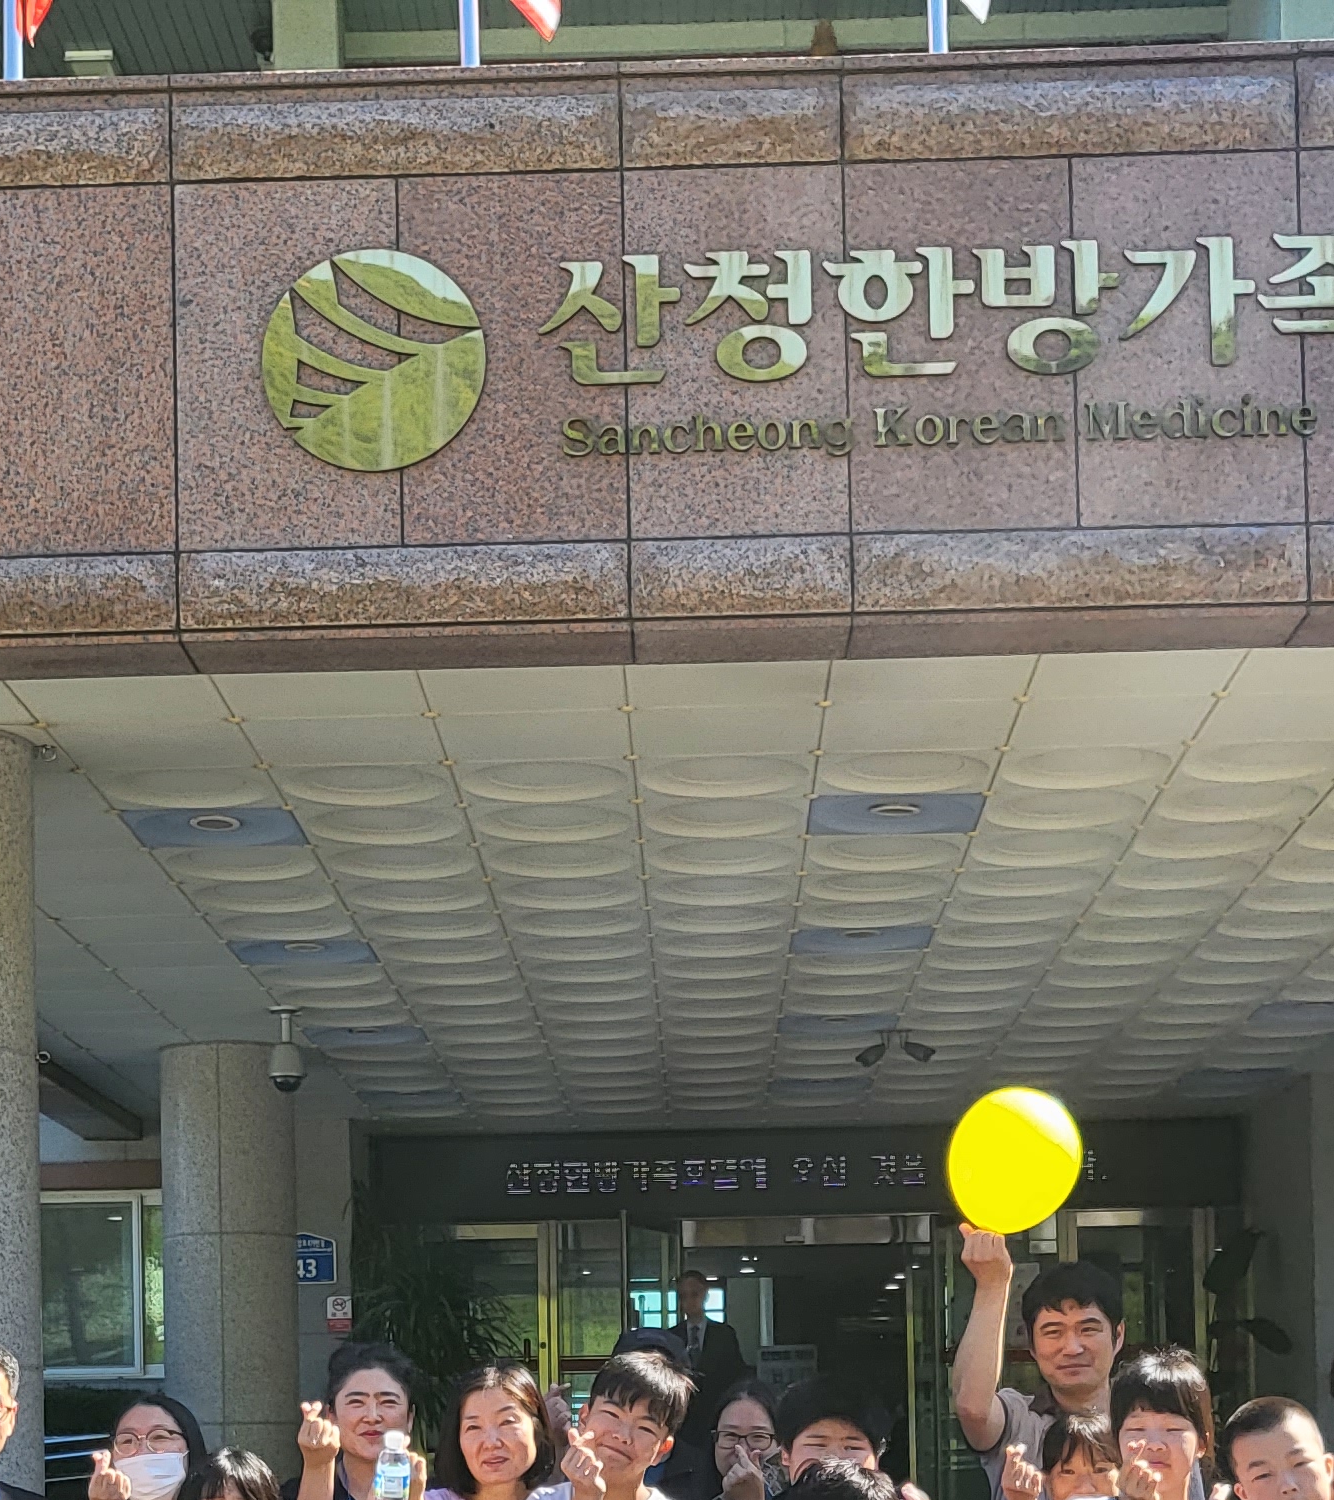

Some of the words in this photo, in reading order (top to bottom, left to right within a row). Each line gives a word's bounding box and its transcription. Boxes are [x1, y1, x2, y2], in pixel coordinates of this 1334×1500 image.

[561, 412, 854, 457] Sancheong
[872, 406, 1065, 449] Korean
[1084, 388, 1318, 441] Medicine
